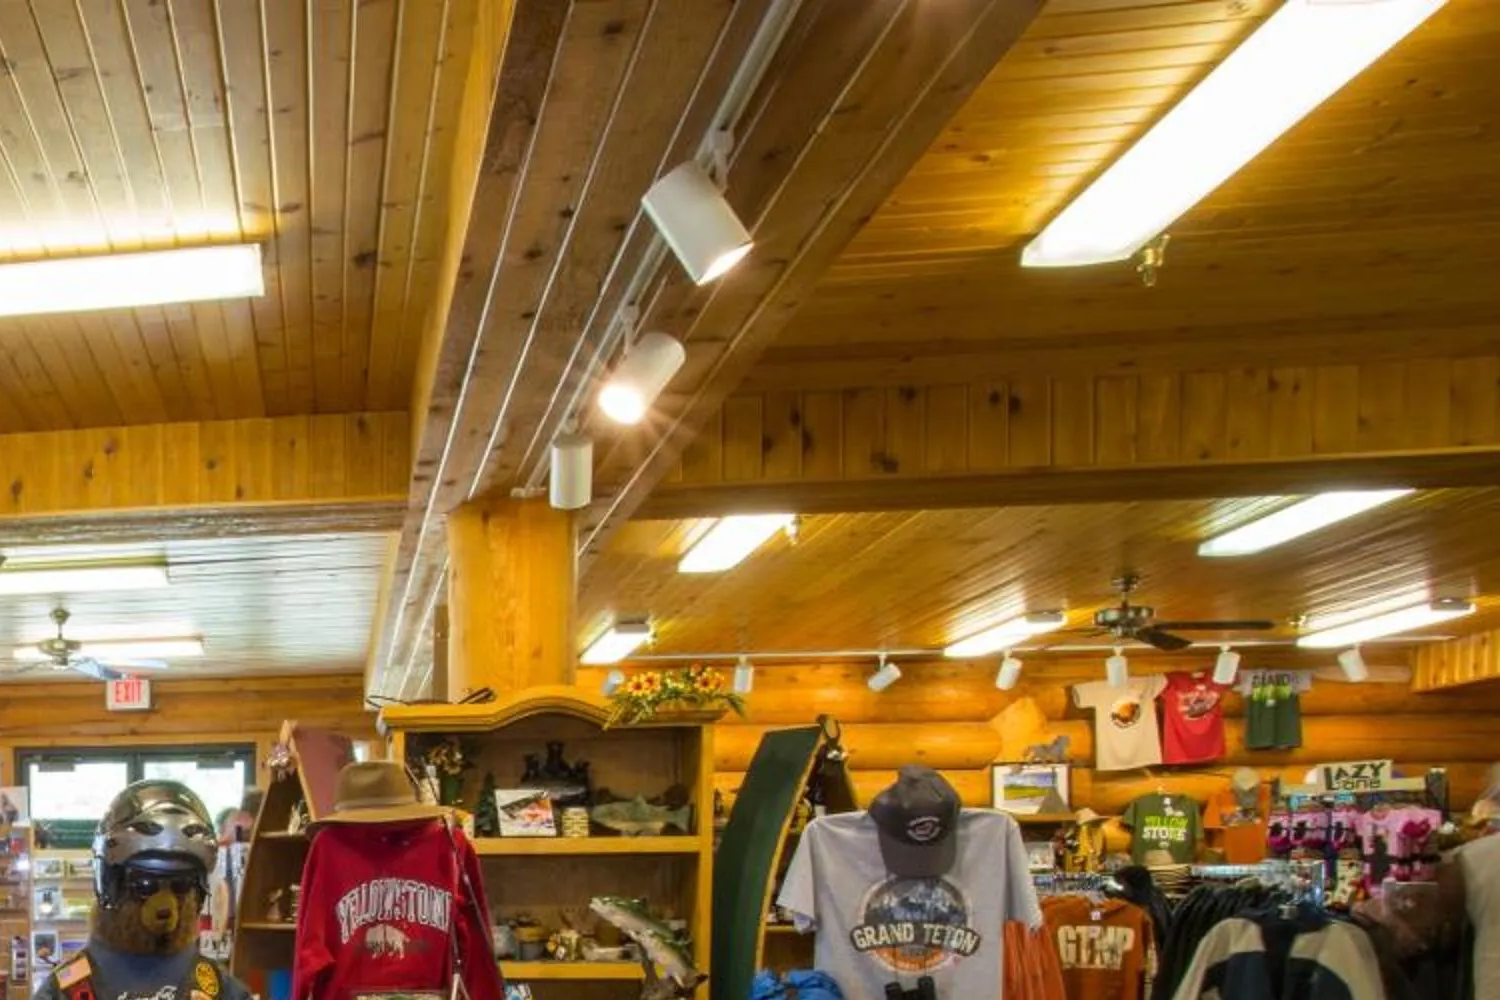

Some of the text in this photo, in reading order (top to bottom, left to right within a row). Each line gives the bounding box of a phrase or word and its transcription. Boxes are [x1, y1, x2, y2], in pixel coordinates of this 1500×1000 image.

[113, 678, 146, 703] EXIT
[1323, 761, 1386, 791] LAZY
[853, 922, 979, 953] GRAND TETON
